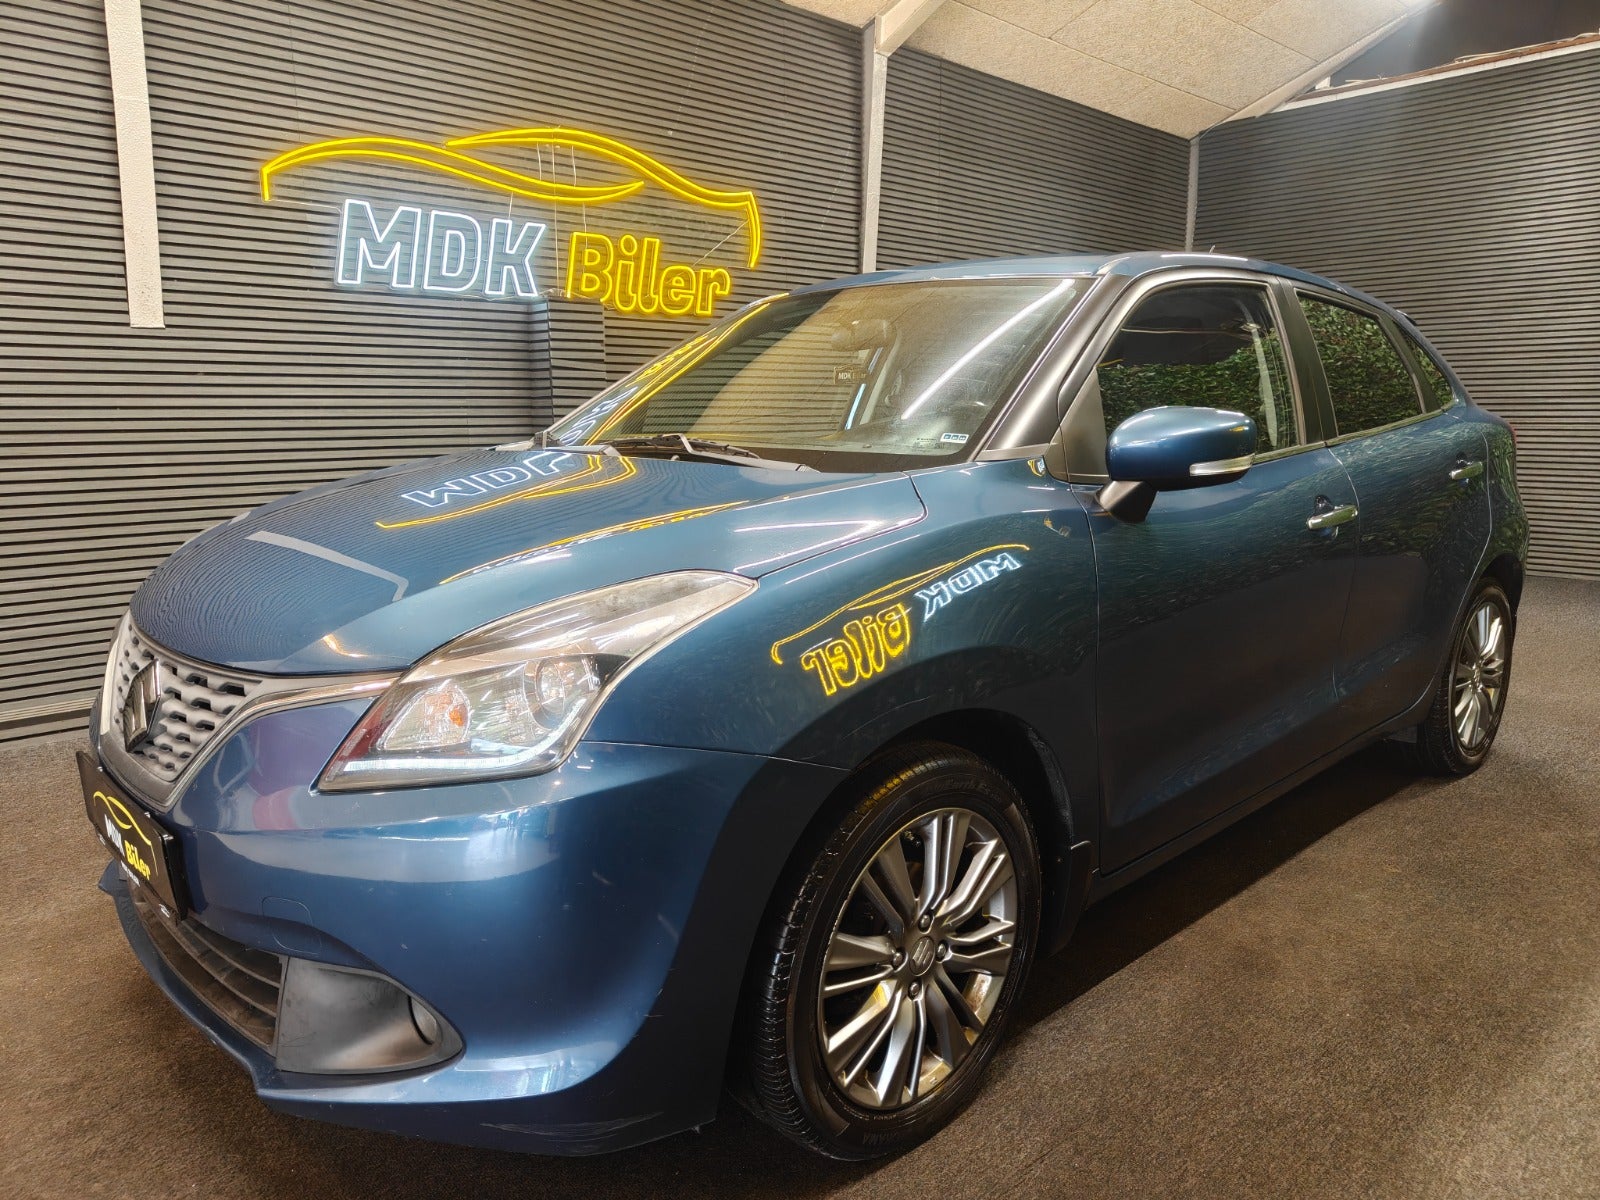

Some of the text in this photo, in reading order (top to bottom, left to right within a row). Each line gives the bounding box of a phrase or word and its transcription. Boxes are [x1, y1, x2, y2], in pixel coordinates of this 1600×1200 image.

[337, 199, 732, 316] MDK Biler
[124, 839, 151, 880] Biler
